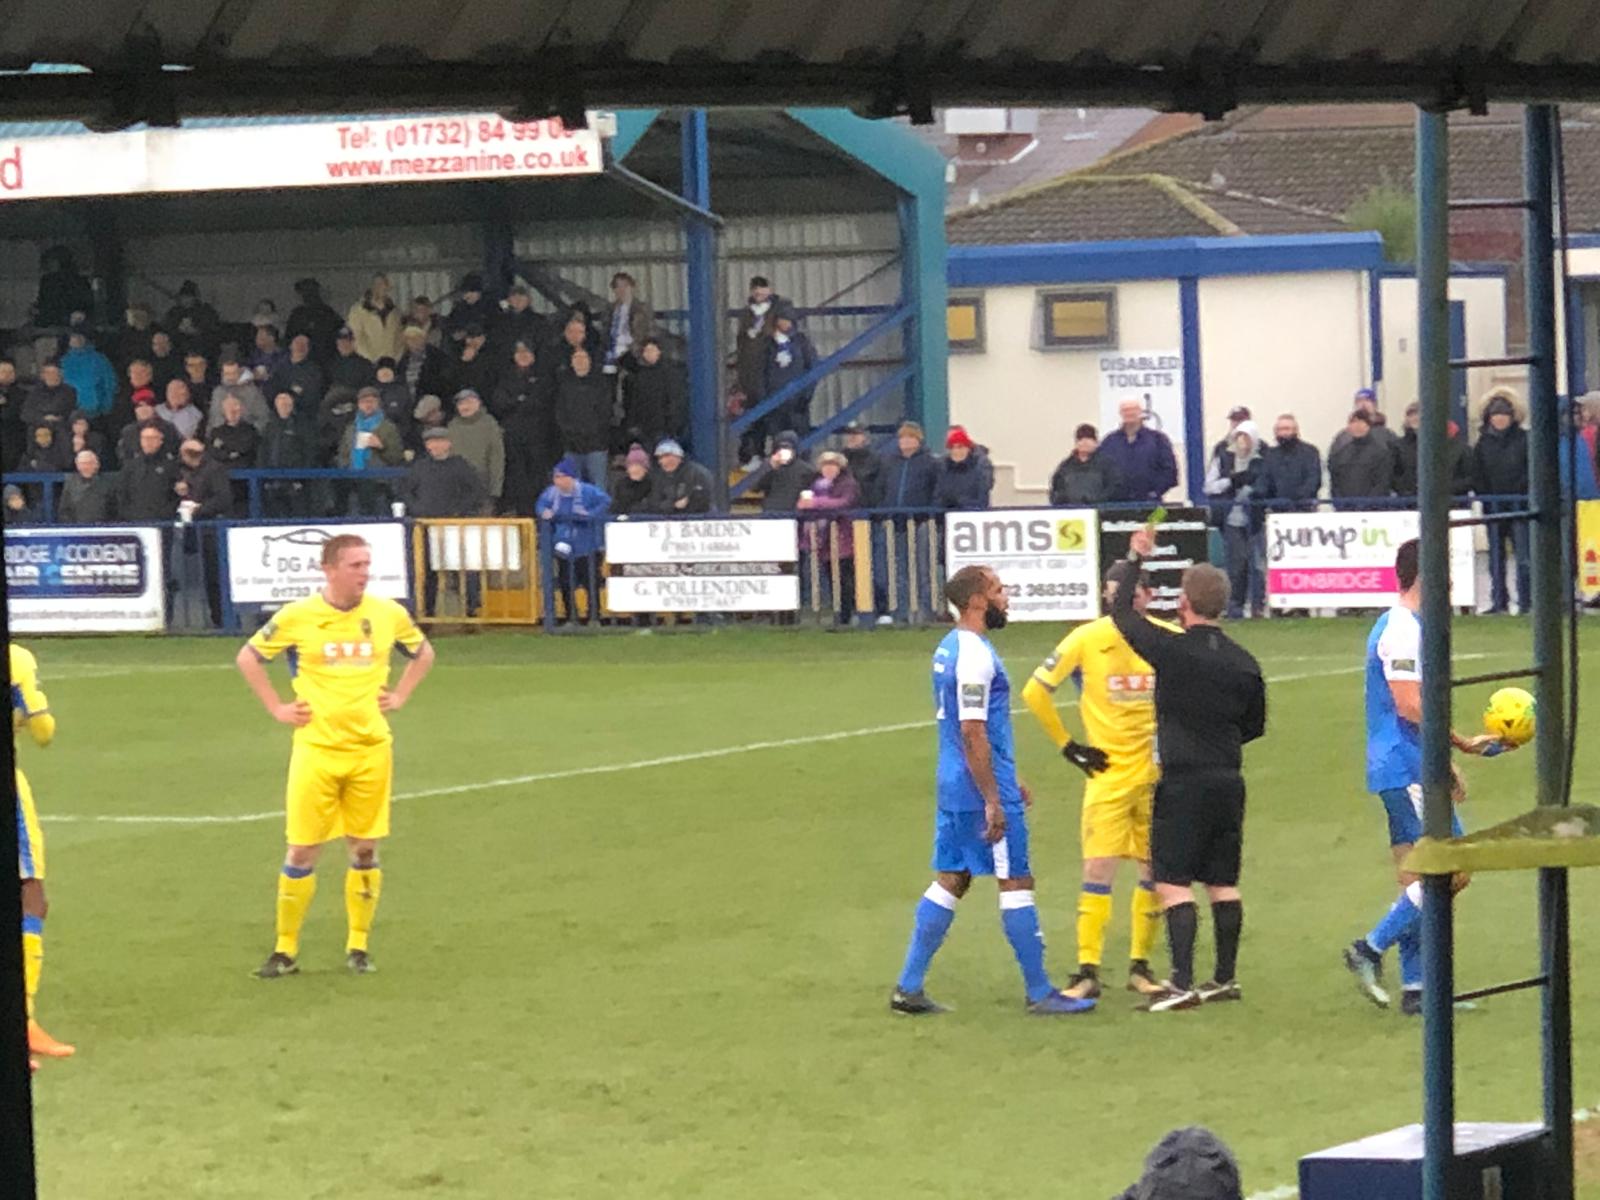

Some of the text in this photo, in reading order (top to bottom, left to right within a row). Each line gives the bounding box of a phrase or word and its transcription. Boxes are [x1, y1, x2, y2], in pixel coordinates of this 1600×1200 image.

[386, 121, 470, 151] (01732)
[326, 145, 589, 177] www.mezzanine.co.uk
[1100, 356, 1181, 371] DISABLED
[1108, 373, 1174, 388] TOILETS
[953, 519, 1053, 553] ams
[1280, 571, 1383, 590] TONBRIDGE
